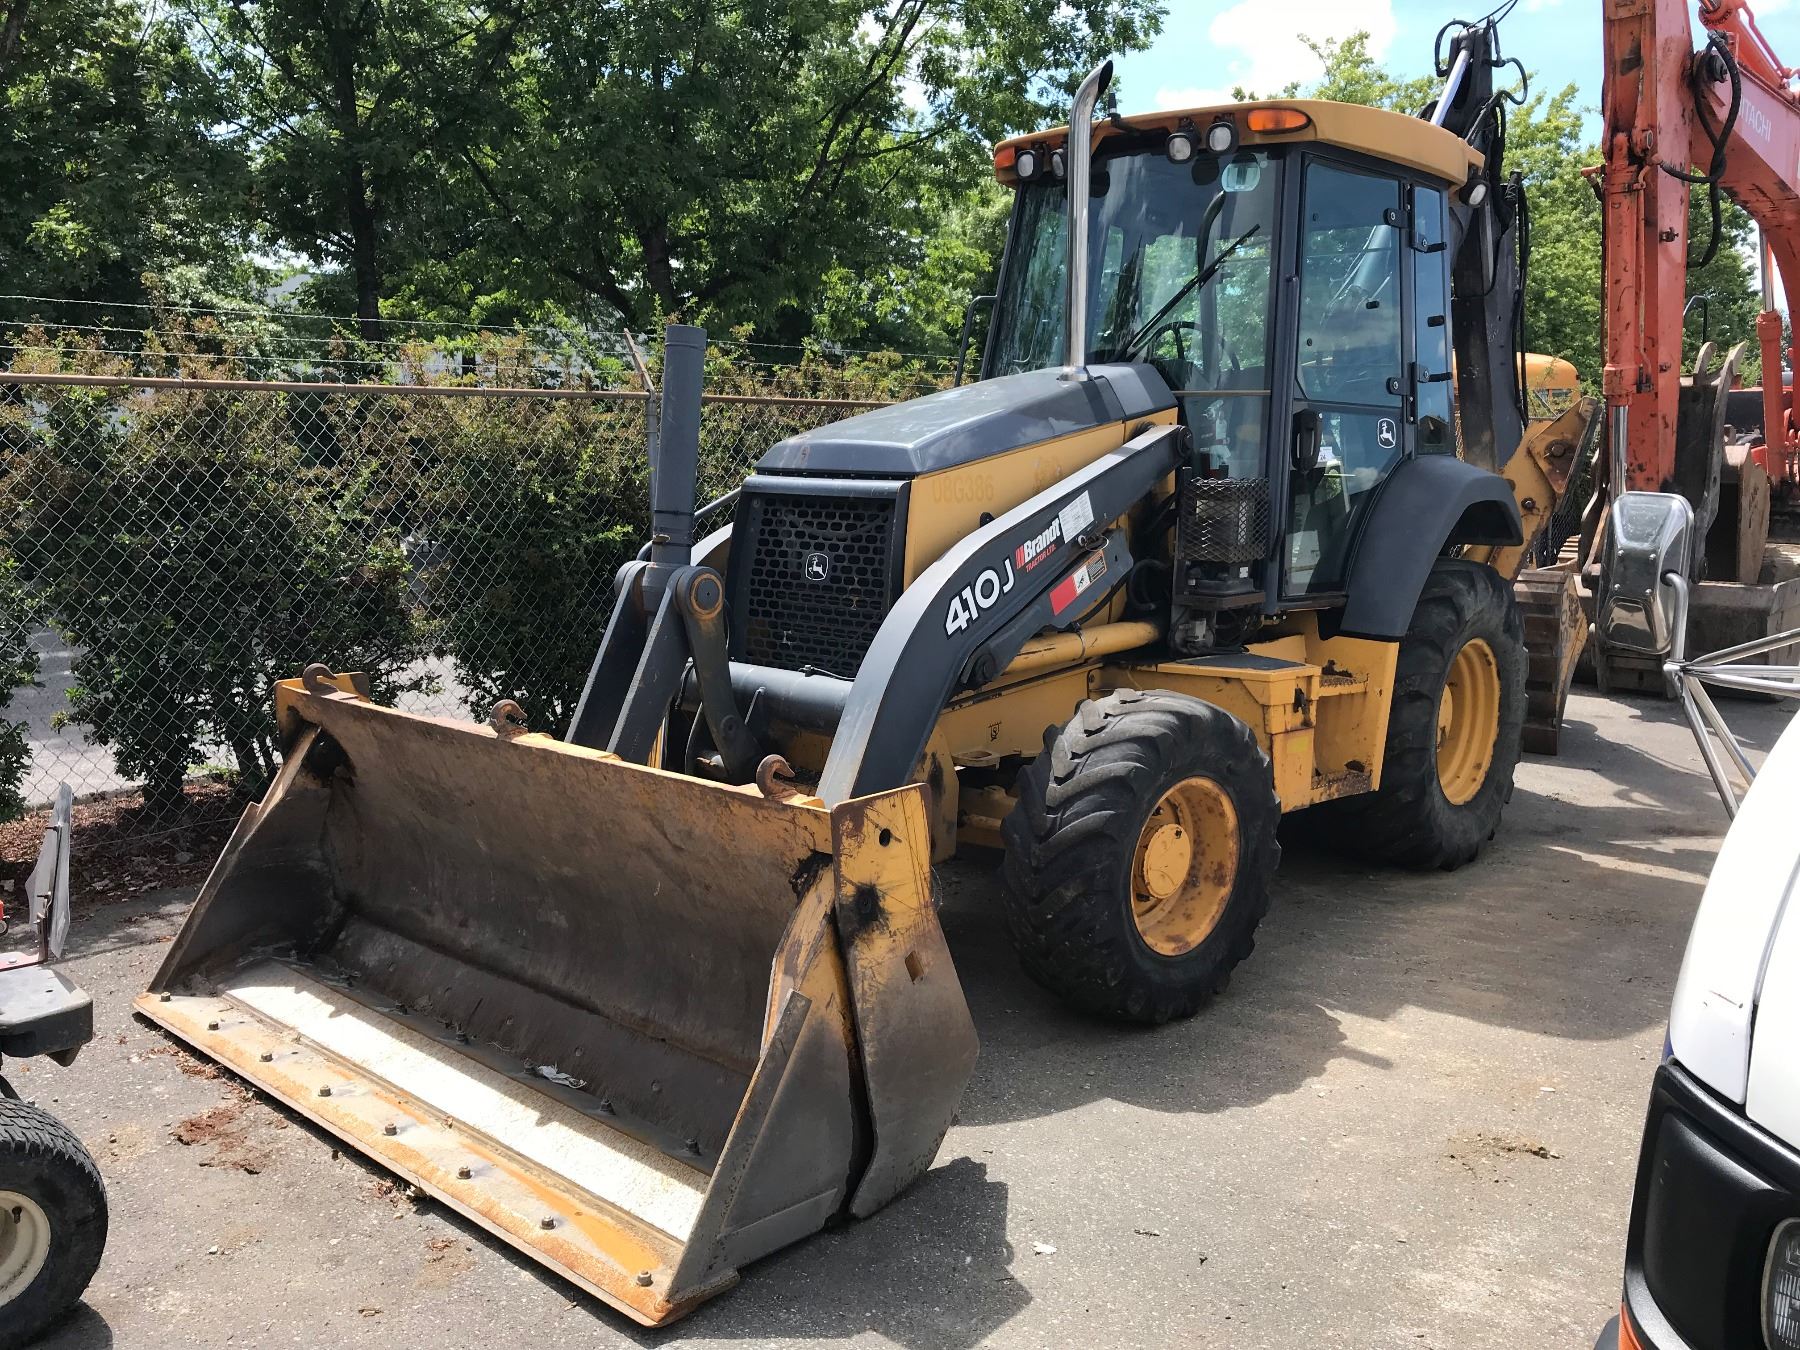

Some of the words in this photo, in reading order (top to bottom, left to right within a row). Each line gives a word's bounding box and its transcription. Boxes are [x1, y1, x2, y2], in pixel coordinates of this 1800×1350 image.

[1023, 517, 1060, 563] Brandt
[1025, 550, 1047, 573] TRACTOR
[945, 557, 1015, 637] 410J
